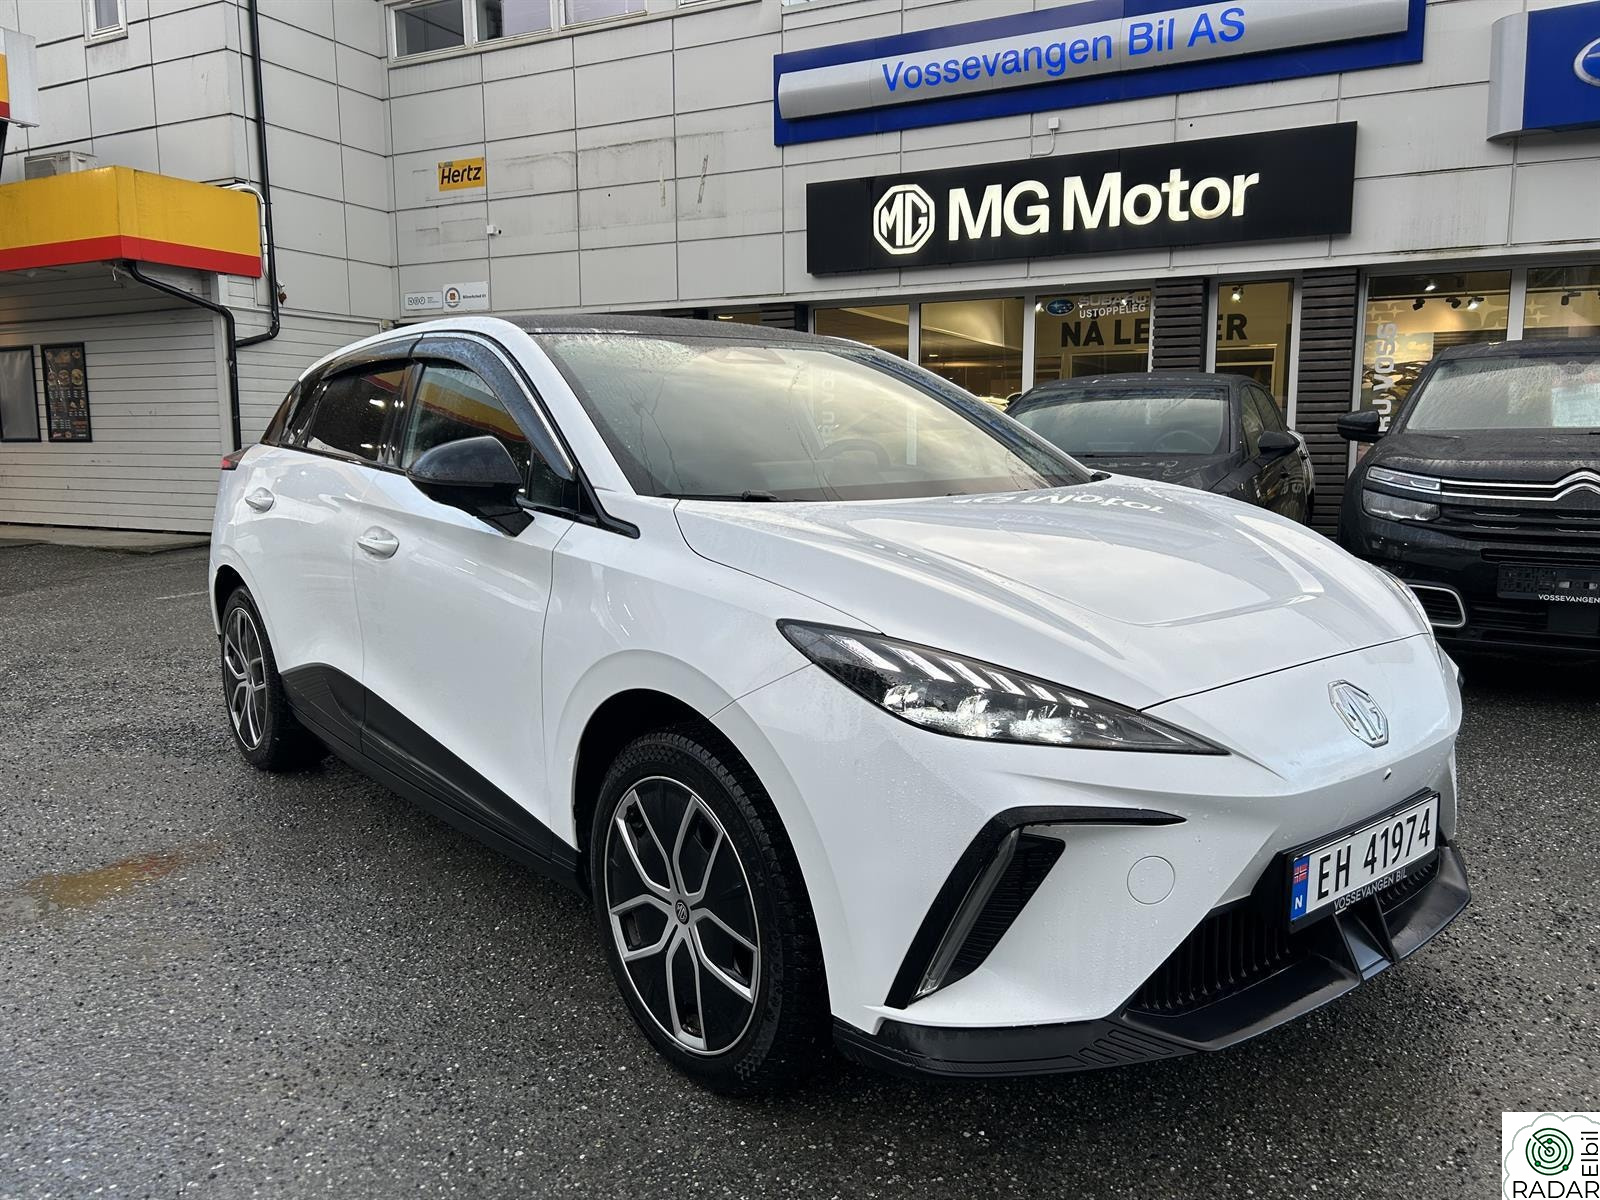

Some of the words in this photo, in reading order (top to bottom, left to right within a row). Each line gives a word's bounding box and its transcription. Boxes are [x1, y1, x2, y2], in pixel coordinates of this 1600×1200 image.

[882, 32, 1112, 91] Vossevangen
[1129, 19, 1174, 56] Bil
[1187, 8, 1245, 47] AS
[441, 165, 482, 184] Hertz
[948, 180, 1050, 241] MG
[1063, 168, 1259, 231] Motor
[877, 187, 932, 251] MG
[1079, 303, 1146, 318] USTOPPELEG
[1373, 323, 1397, 391] VOSS
[1538, 594, 1600, 604] VOSSEVANGEN
[1294, 895, 1303, 910] N
[1317, 845, 1351, 900] EH
[1363, 808, 1430, 874] 41974
[1334, 875, 1393, 911] VOSSEVANGEN
[1395, 868, 1407, 882] BIL
